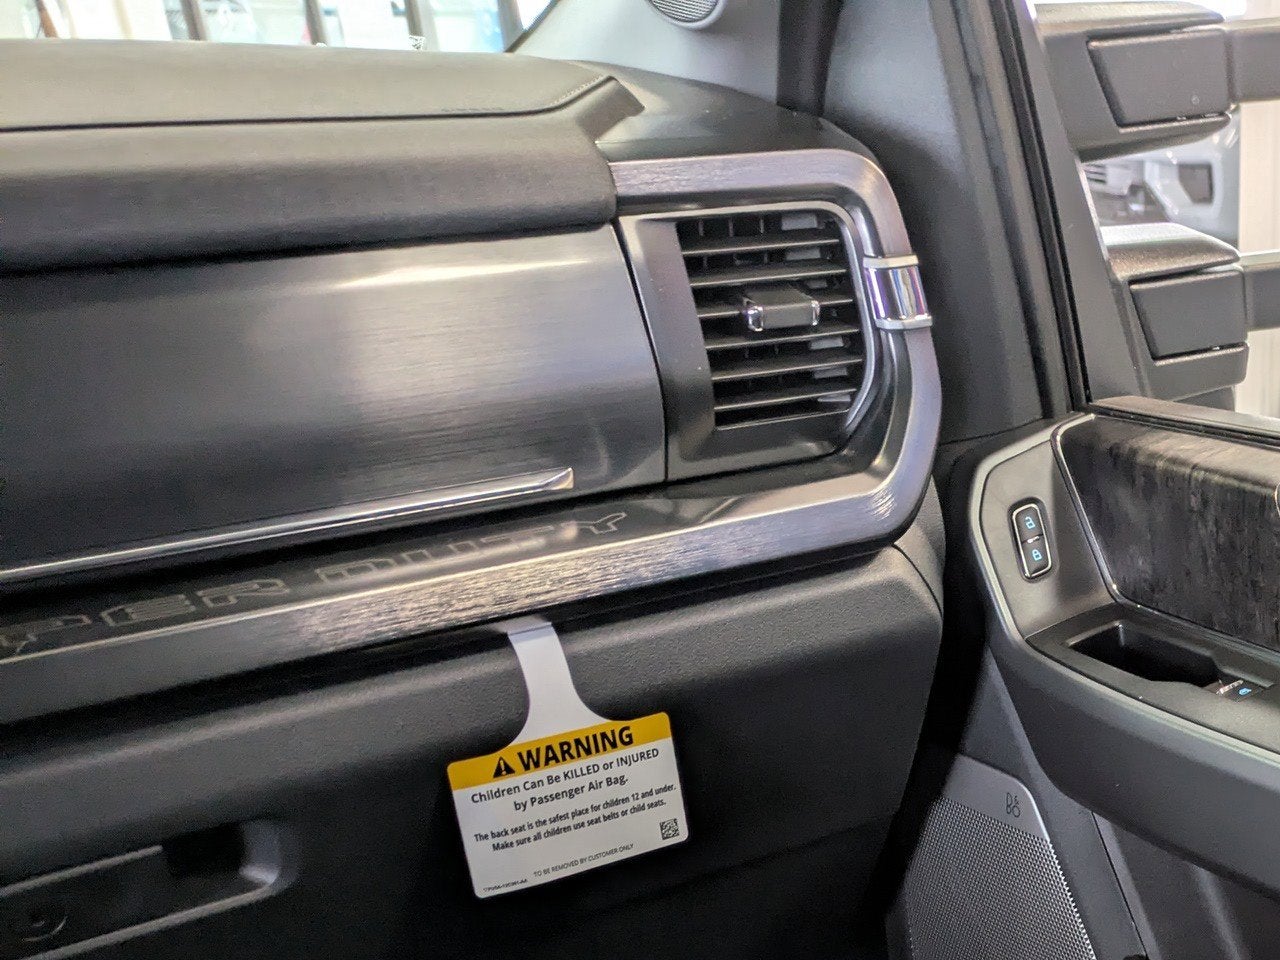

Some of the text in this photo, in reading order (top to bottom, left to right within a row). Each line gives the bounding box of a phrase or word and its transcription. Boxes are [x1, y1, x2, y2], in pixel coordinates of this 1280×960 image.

[517, 726, 634, 771] WARNING
[471, 748, 659, 803] Children Can Be KILLED or INJURED
[514, 775, 628, 811] by Passenger Air Bag.
[474, 784, 676, 841] The back seat is the safest place for children 12 and under.
[492, 799, 666, 851] Make sure all children use seat belts or child seats.
[551, 859, 579, 872] REMOVED
[580, 856, 587, 864] BY
[588, 848, 617, 862] CUSTOMER
[619, 844, 634, 853] ONLY
